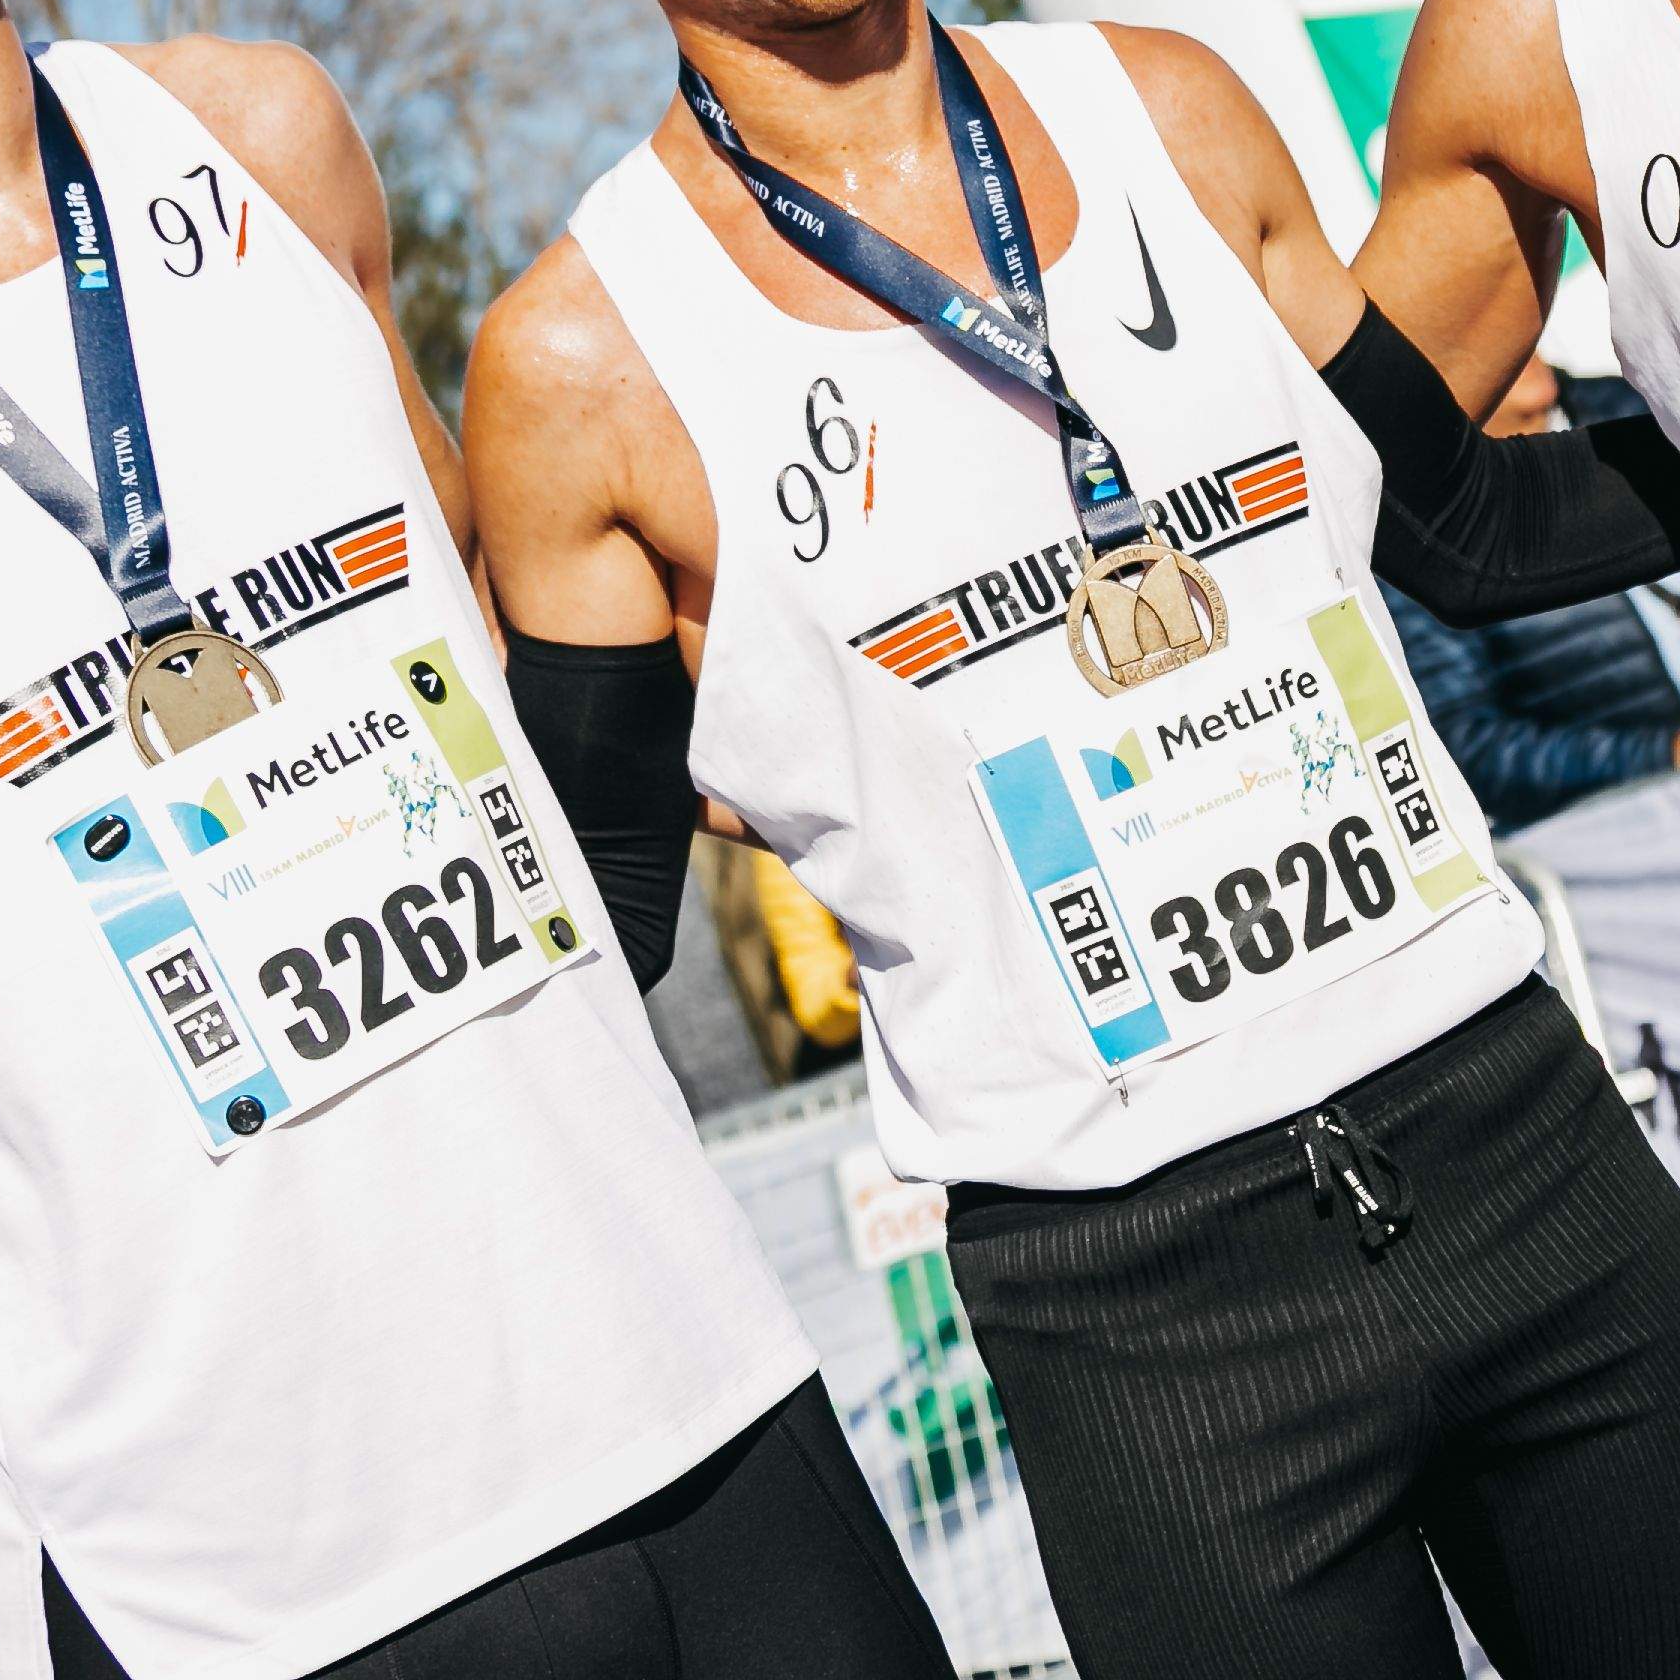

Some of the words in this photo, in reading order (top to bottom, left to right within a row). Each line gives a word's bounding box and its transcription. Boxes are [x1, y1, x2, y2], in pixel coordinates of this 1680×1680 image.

[966, 118, 996, 170] ACTIVA
[63, 182, 100, 256] MetLife
[771, 195, 826, 238] ACTIVA
[983, 174, 1016, 241] MADRID
[1003, 242, 1038, 316] METLIFE
[974, 318, 1053, 380] MetLife
[112, 425, 139, 486] ACTIVA
[124, 491, 151, 569] MADRID
[1141, 470, 1243, 552] RUN
[231, 537, 347, 631] RUN
[1121, 650, 1200, 686] MetLife
[1156, 667, 1321, 762] MetLife
[245, 709, 411, 811] MetLife
[1111, 812, 1157, 847] VIII
[206, 863, 258, 901] VIII
[1149, 814, 1397, 1004] 3826
[258, 855, 523, 1062] 3262
